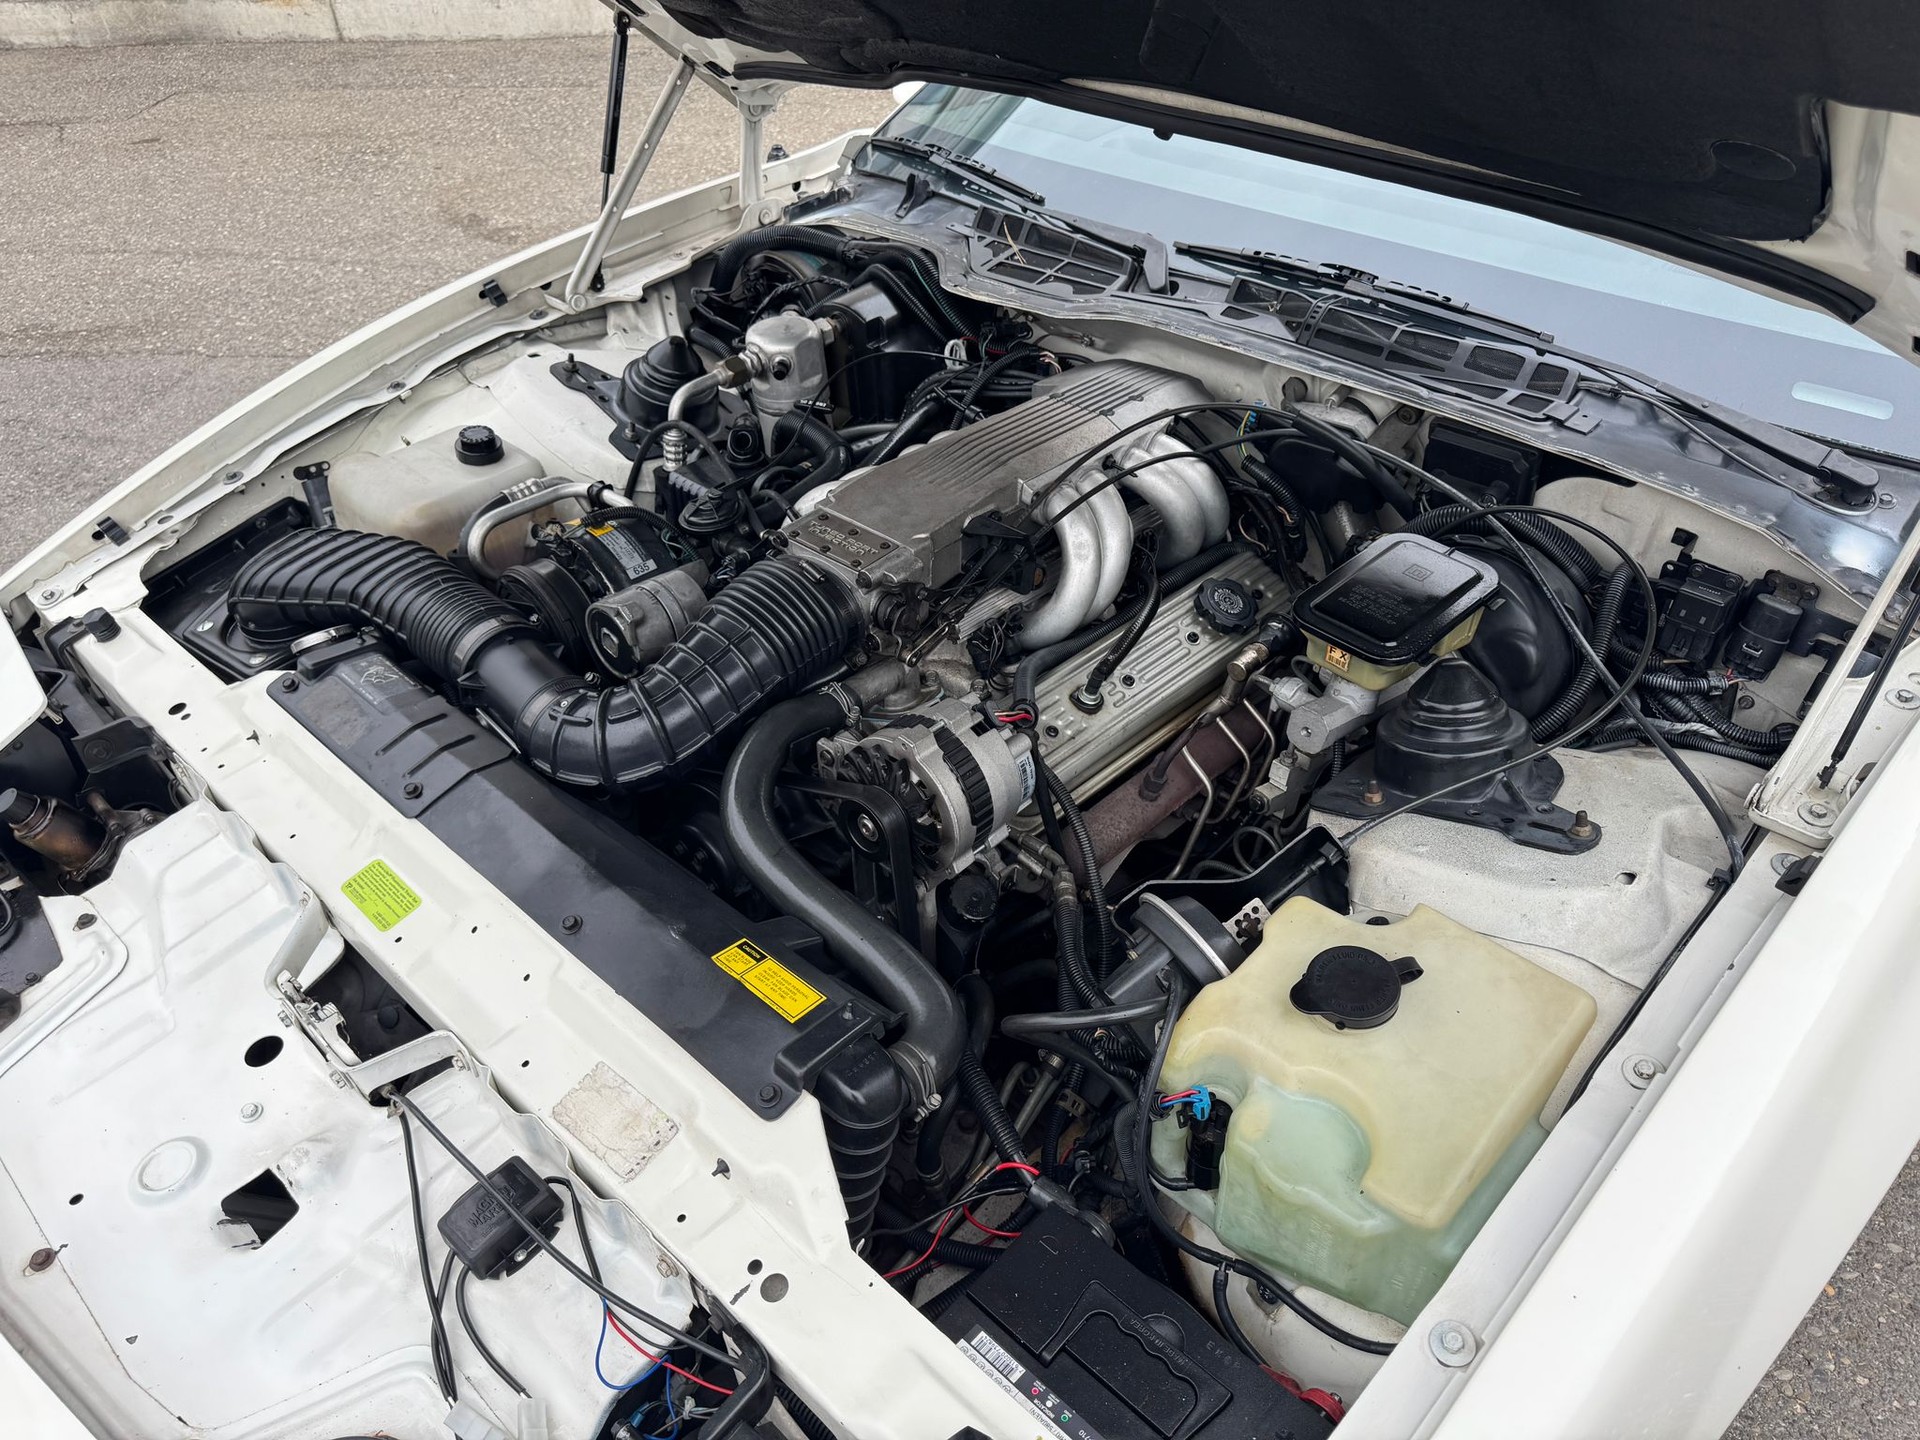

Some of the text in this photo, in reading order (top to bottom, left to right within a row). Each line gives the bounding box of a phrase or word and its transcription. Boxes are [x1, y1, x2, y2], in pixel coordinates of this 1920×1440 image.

[809, 528, 865, 556] INJECTION
[810, 520, 878, 554] TUNED PORT
[633, 564, 650, 575] 635
[742, 945, 761, 958] CAUTION
[1130, 1318, 1156, 1340] KOREA
[1154, 1338, 1163, 1348] IN
[1162, 1345, 1186, 1365] MADE
[1033, 1398, 1055, 1419] INDICATOR
